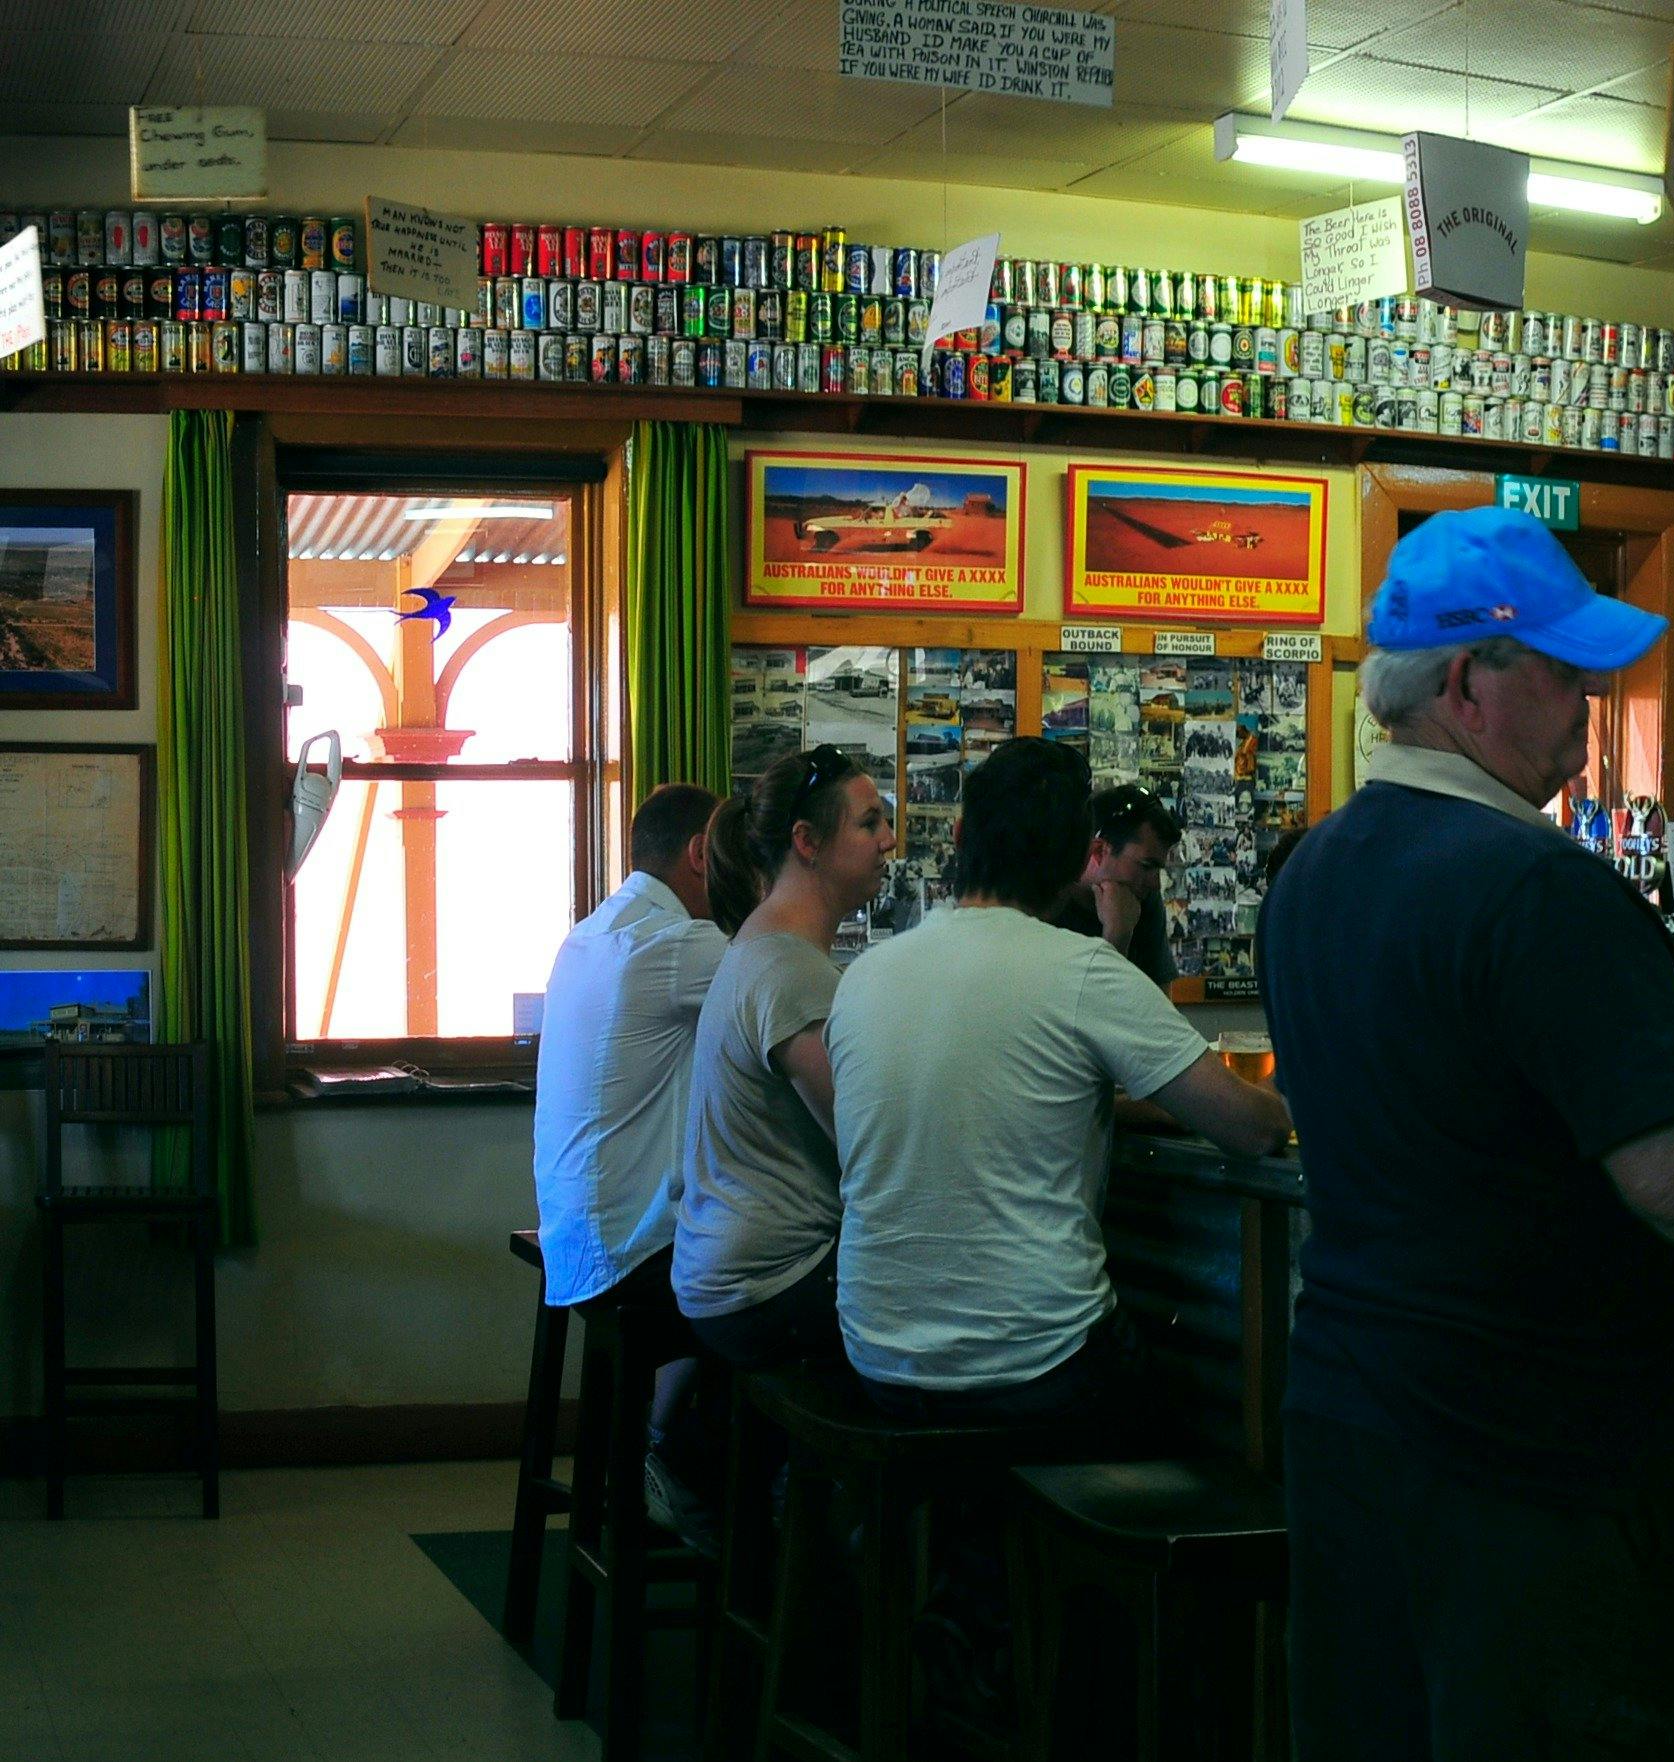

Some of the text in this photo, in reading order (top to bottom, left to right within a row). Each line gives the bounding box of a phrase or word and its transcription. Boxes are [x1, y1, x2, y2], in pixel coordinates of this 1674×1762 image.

[919, 0, 972, 16] POLITICAL
[977, 1, 1017, 19] SPEECH
[1082, 12, 1107, 29] WAS
[893, 14, 1111, 52] A WOMAN IF YOU WERE MY
[844, 25, 1095, 64] HUSBAND MAKE YOU A CUP OF
[841, 41, 1070, 79] TEA WITH POISON IN WINSTON
[840, 60, 1043, 95] IF YOU WERE MY WIFE DRINK
[1404, 139, 1427, 258] 08 8088 5313
[1324, 217, 1349, 234] Beer
[1436, 206, 1519, 256] THE ORIGINAL
[1326, 229, 1354, 246] Good
[1303, 247, 1321, 266] My
[1503, 481, 1571, 520] EXIT
[763, 563, 1006, 584] AUSTRALIANS GIVE A XXXX
[820, 581, 915, 598] FOR ANYTHING
[1084, 573, 1309, 596] AUSTRALIANS WOULDN'T GIVE A XXXX
[1137, 591, 1225, 607] FOR ANYTHING
[1062, 629, 1120, 640] OUTBACK
[1157, 634, 1211, 643] IN PURSUIT
[1266, 635, 1315, 647] RING OF
[1070, 641, 1112, 651] BOUND
[1167, 644, 1212, 653] HONOUR
[1265, 648, 1319, 659] SCORPIO
